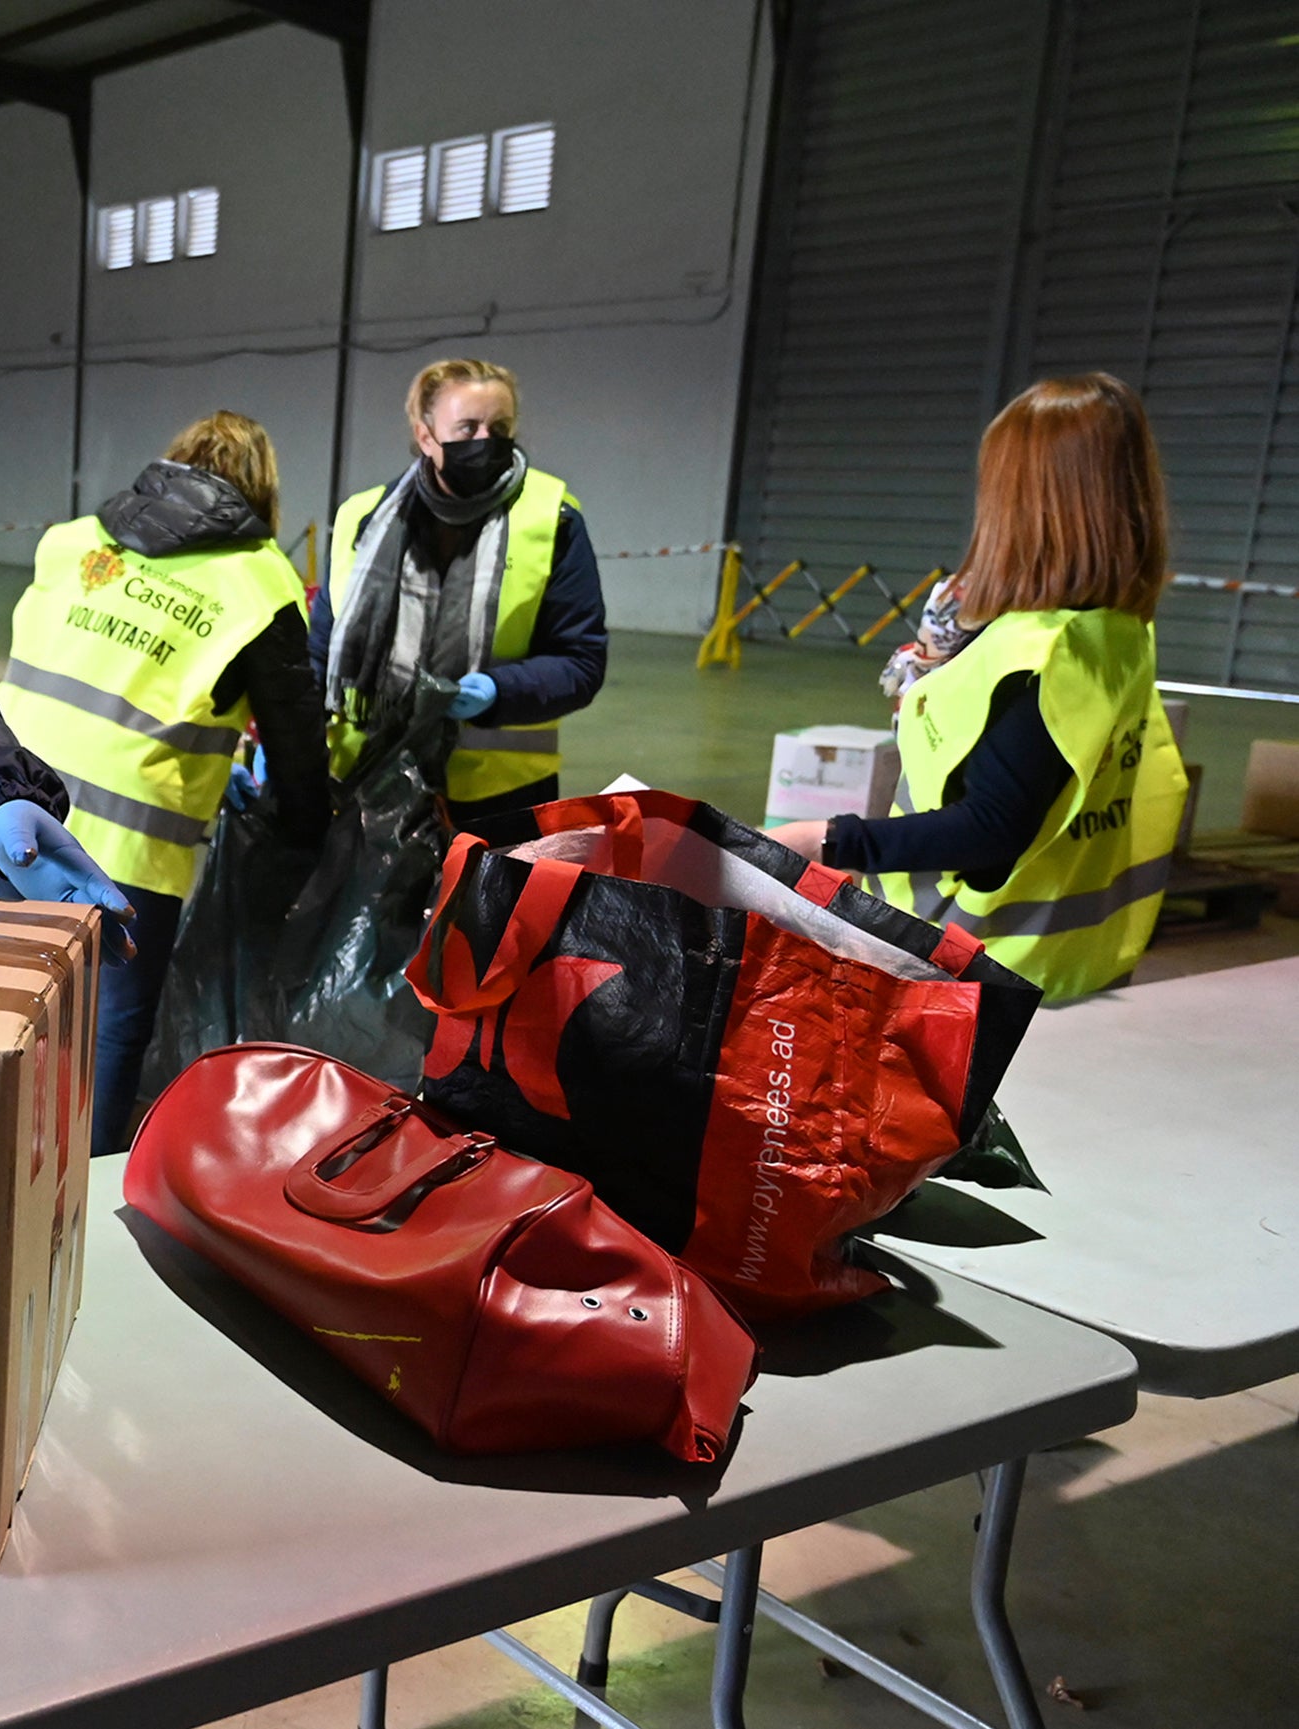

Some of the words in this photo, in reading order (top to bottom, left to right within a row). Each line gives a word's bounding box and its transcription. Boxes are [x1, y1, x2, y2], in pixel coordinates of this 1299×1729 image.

[66, 605, 177, 667] VOLUNTARIAT
[124, 577, 217, 638] Castelló
[734, 1018, 796, 1283] www.pyrenees.ad
